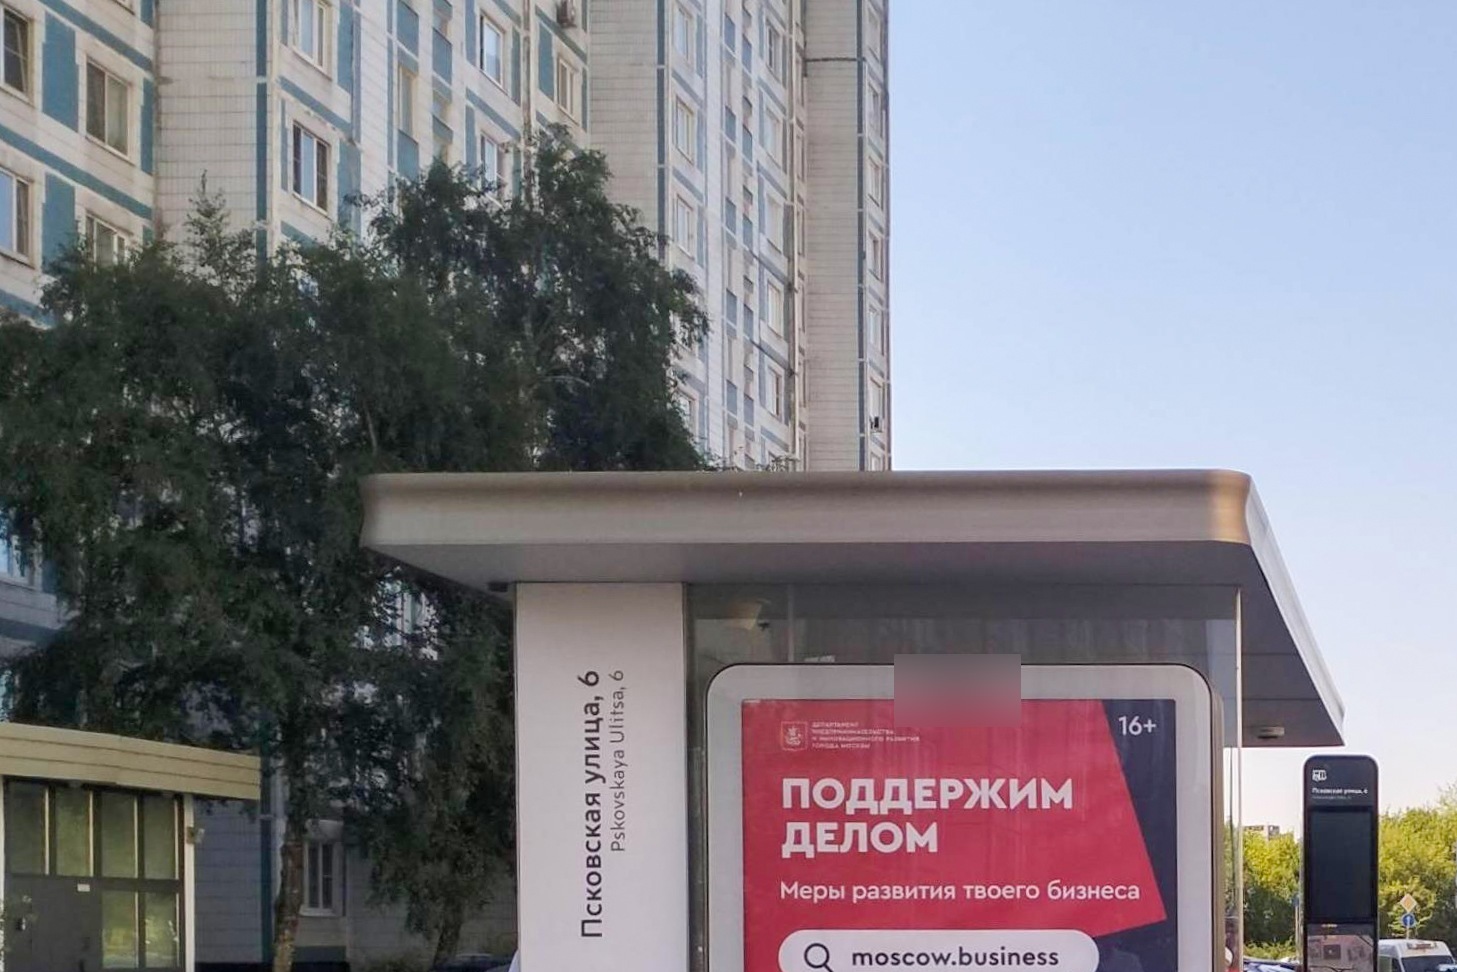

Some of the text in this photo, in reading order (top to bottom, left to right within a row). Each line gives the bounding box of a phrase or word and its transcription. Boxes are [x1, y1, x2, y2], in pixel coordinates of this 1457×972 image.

[1118, 715, 1157, 736] 16+
[608, 669, 628, 852] Pskovskaya Ulitsa, 6
[577, 670, 606, 939] Псковская улица, 6
[782, 778, 1073, 815] ПОДДЕРЖИМ
[781, 822, 938, 858] ДЕЛОМ
[780, 879, 1140, 904] Меры развития твоего бизнеса
[852, 947, 1060, 967] moscow.business
